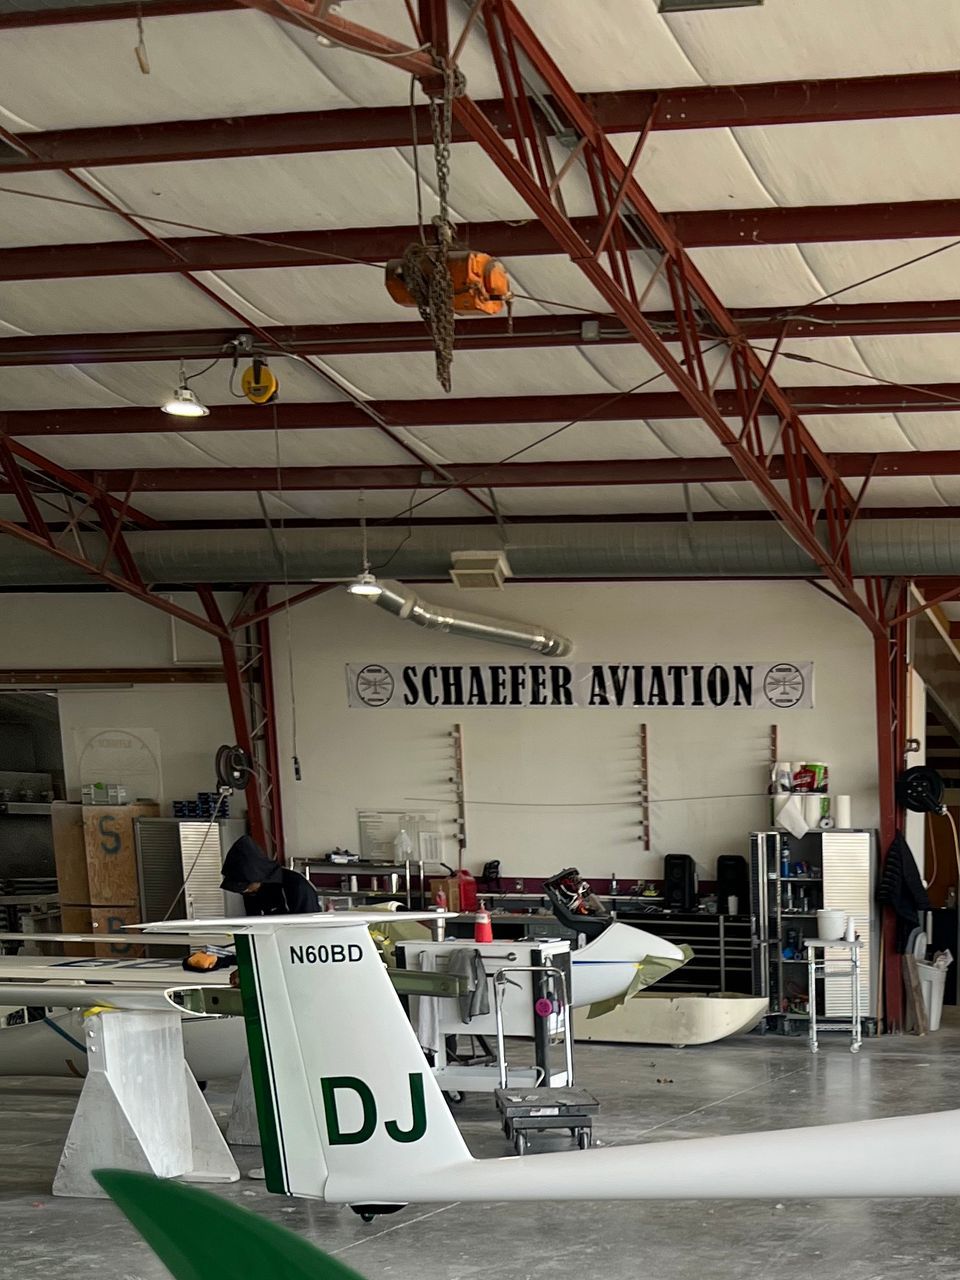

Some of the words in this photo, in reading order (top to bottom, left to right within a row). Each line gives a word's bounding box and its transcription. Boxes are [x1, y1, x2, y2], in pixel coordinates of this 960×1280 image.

[402, 665, 574, 706] SCHAEFER
[588, 665, 754, 706] AVIATION
[98, 815, 122, 855] S
[289, 944, 363, 964] N60BD
[320, 1072, 428, 1146] DJ
